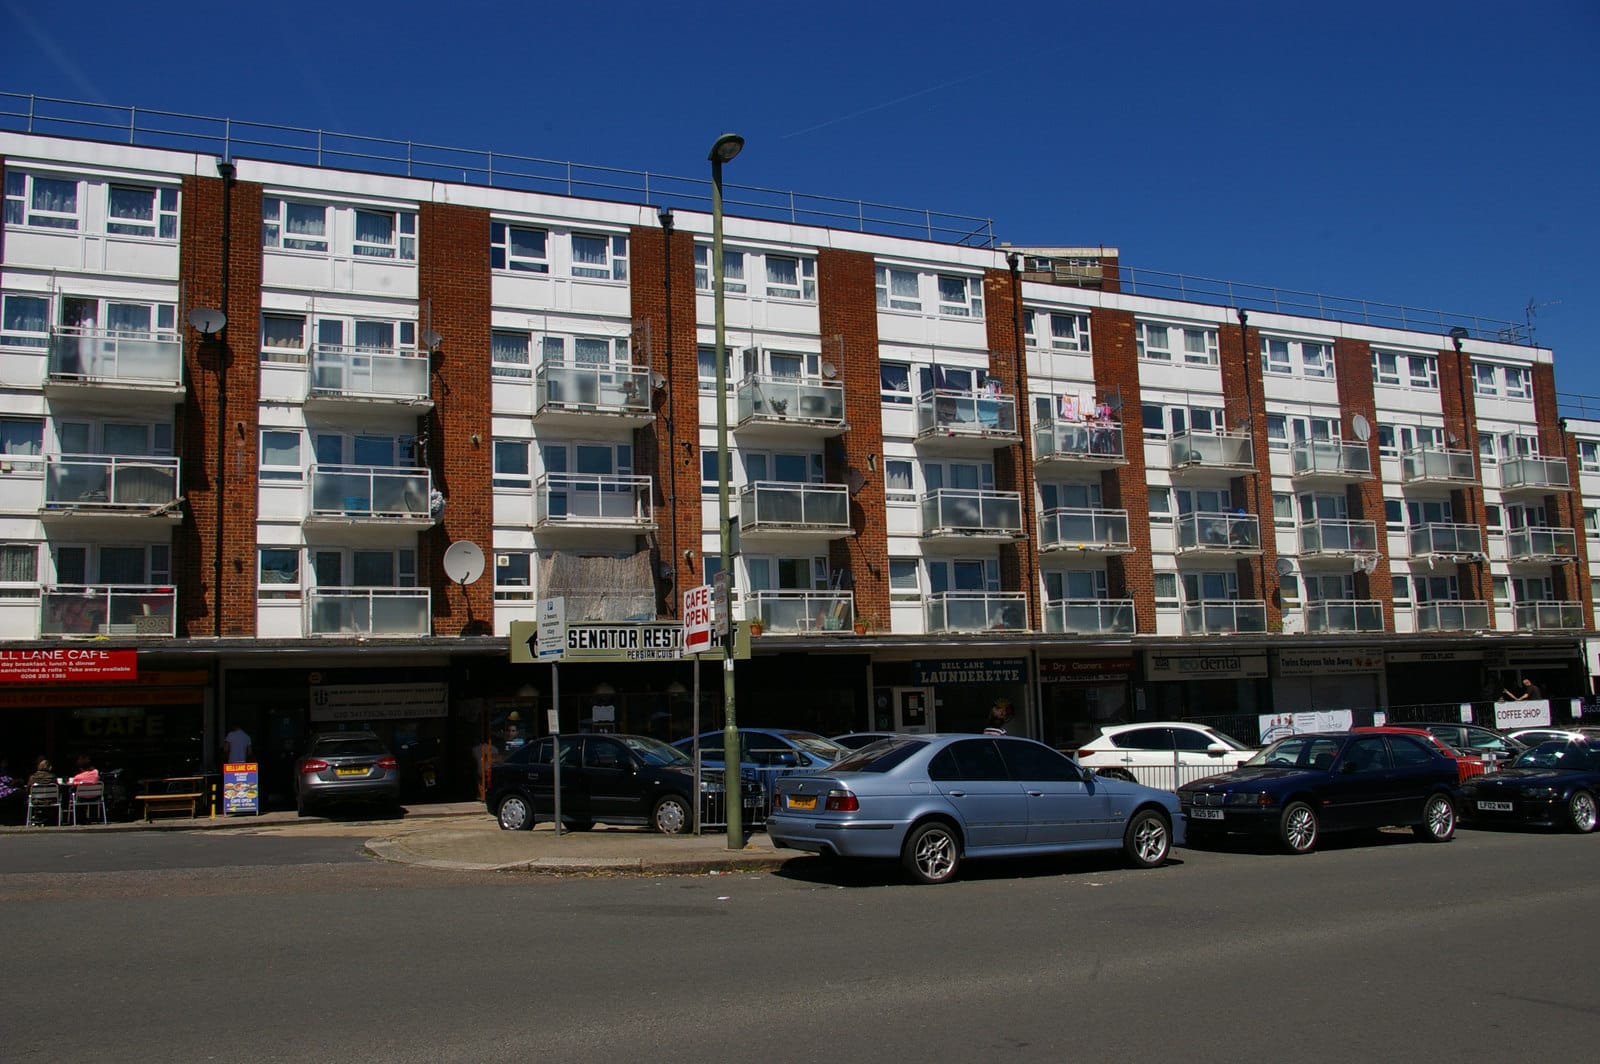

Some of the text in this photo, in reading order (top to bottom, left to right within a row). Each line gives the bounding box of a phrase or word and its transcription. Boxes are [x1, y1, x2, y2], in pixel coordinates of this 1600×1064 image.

[685, 588, 708, 609] CAFE
[685, 608, 709, 628] OPEN
[567, 628, 738, 649] SENATOR RESTAT
[22, 650, 64, 660] LANE
[67, 649, 110, 660] CAFE
[627, 649, 684, 659] PERSIAN CUISIE
[963, 661, 984, 669] LANE
[1052, 662, 1066, 672] Dry
[920, 669, 1020, 683] LAUNDERETTE
[1497, 708, 1541, 720] COFFEE SHOP
